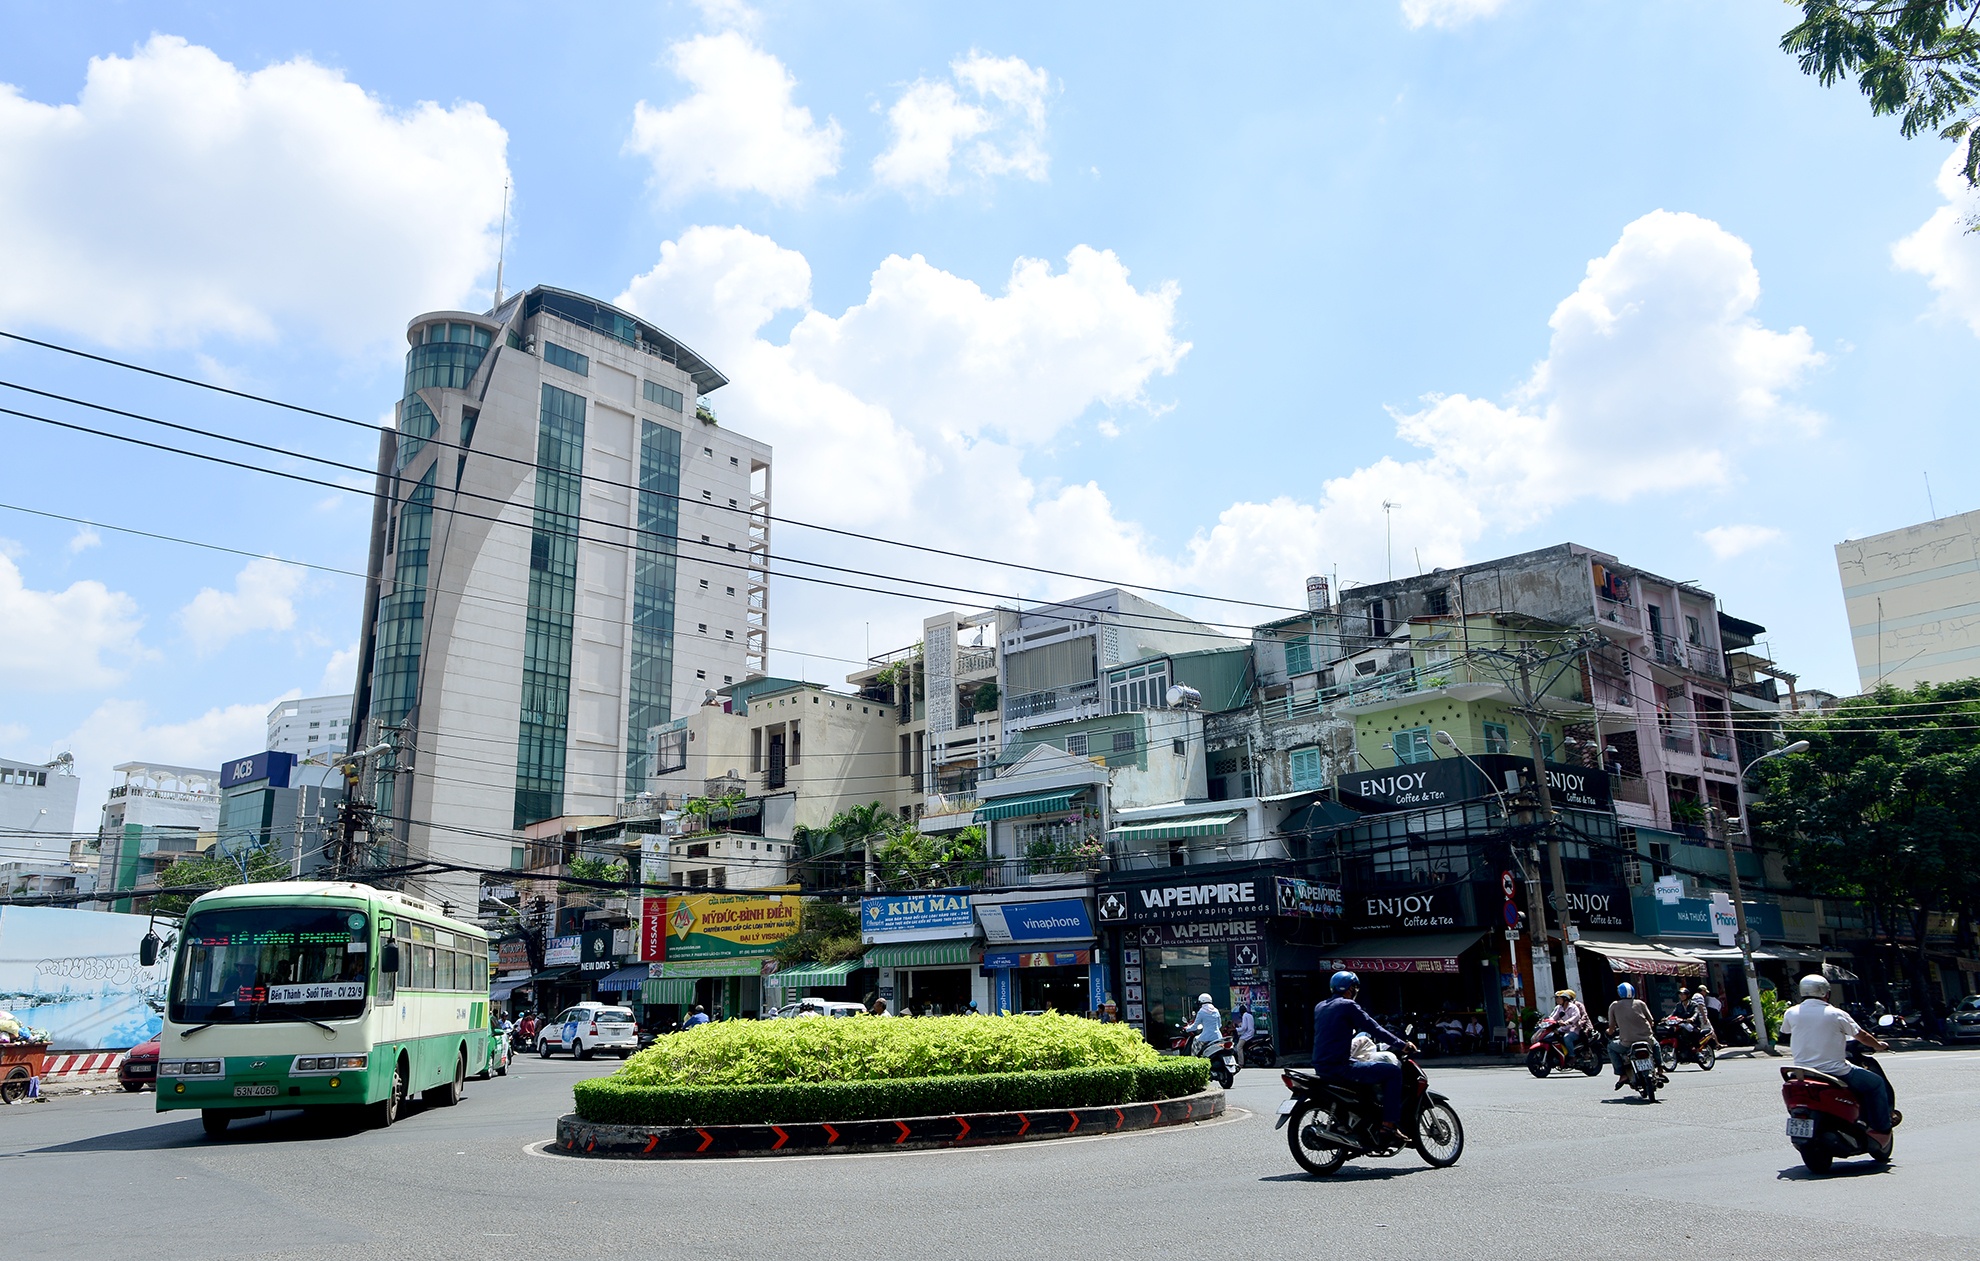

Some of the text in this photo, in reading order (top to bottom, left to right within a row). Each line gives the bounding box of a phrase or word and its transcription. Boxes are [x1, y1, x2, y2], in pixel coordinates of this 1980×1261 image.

[232, 760, 253, 780] ACB
[1360, 771, 1427, 797] ENJOY
[1395, 790, 1445, 805] Coffee & Tea
[1566, 792, 1581, 802] Coffee
[1140, 882, 1255, 909] VAPEMPIRE
[1297, 885, 1342, 902] VAPEMPIRE
[767, 902, 793, 920] ĐIỀN
[888, 896, 968, 916] KIM MAI
[1367, 895, 1434, 917] ENJOY
[1568, 893, 1610, 914] ENJOY
[1134, 912, 1150, 920] for
[1170, 909, 1194, 918] your
[1198, 905, 1234, 917] vaping
[1237, 903, 1270, 914] needs
[1677, 911, 1690, 921] NHÀ
[1690, 910, 1708, 922] THUỐC
[1715, 912, 1737, 926] Phano
[1022, 916, 1080, 930] vinaphone
[1403, 916, 1454, 927] Coffee & Tea
[1590, 914, 1622, 925] Coffee & Tea
[650, 916, 658, 957] VISSAN
[752, 932, 760, 941] LÝ
[1171, 920, 1257, 938] VAPEMPIRE
[581, 960, 611, 971] NEW DAYS
[1347, 958, 1412, 972] Enjoy
[239, 986, 267, 1002] 53
[271, 988, 283, 1000] Bến
[284, 986, 301, 1000] Thành
[306, 986, 319, 998] Suối
[320, 985, 333, 998] Tiên
[338, 986, 347, 998] CV
[347, 986, 363, 998] 23/9
[1789, 1128, 1809, 1136] 4780
